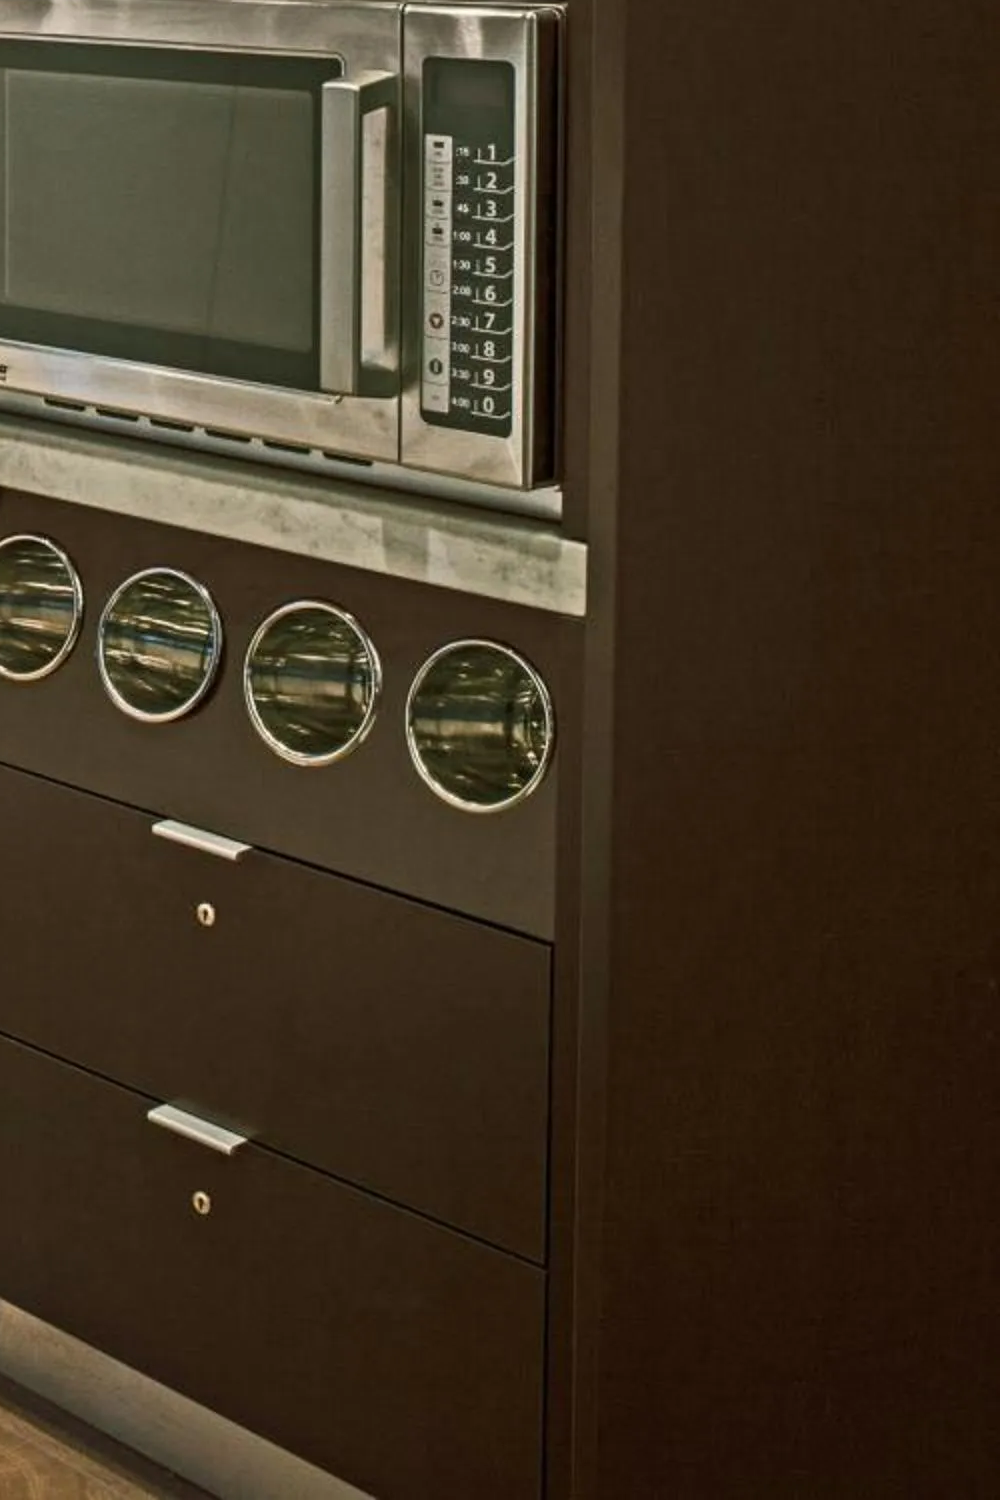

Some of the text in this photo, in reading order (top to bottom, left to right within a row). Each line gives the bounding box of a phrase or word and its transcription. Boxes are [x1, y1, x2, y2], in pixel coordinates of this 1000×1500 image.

[487, 143, 496, 160] 1
[486, 171, 497, 189] 2
[485, 200, 497, 217] 3
[485, 228, 497, 244] 4
[485, 256, 496, 273] 5
[484, 285, 497, 301] 6
[484, 311, 496, 329] 7
[483, 340, 495, 357] 8
[482, 368, 495, 385] 9
[482, 396, 495, 413] 0
